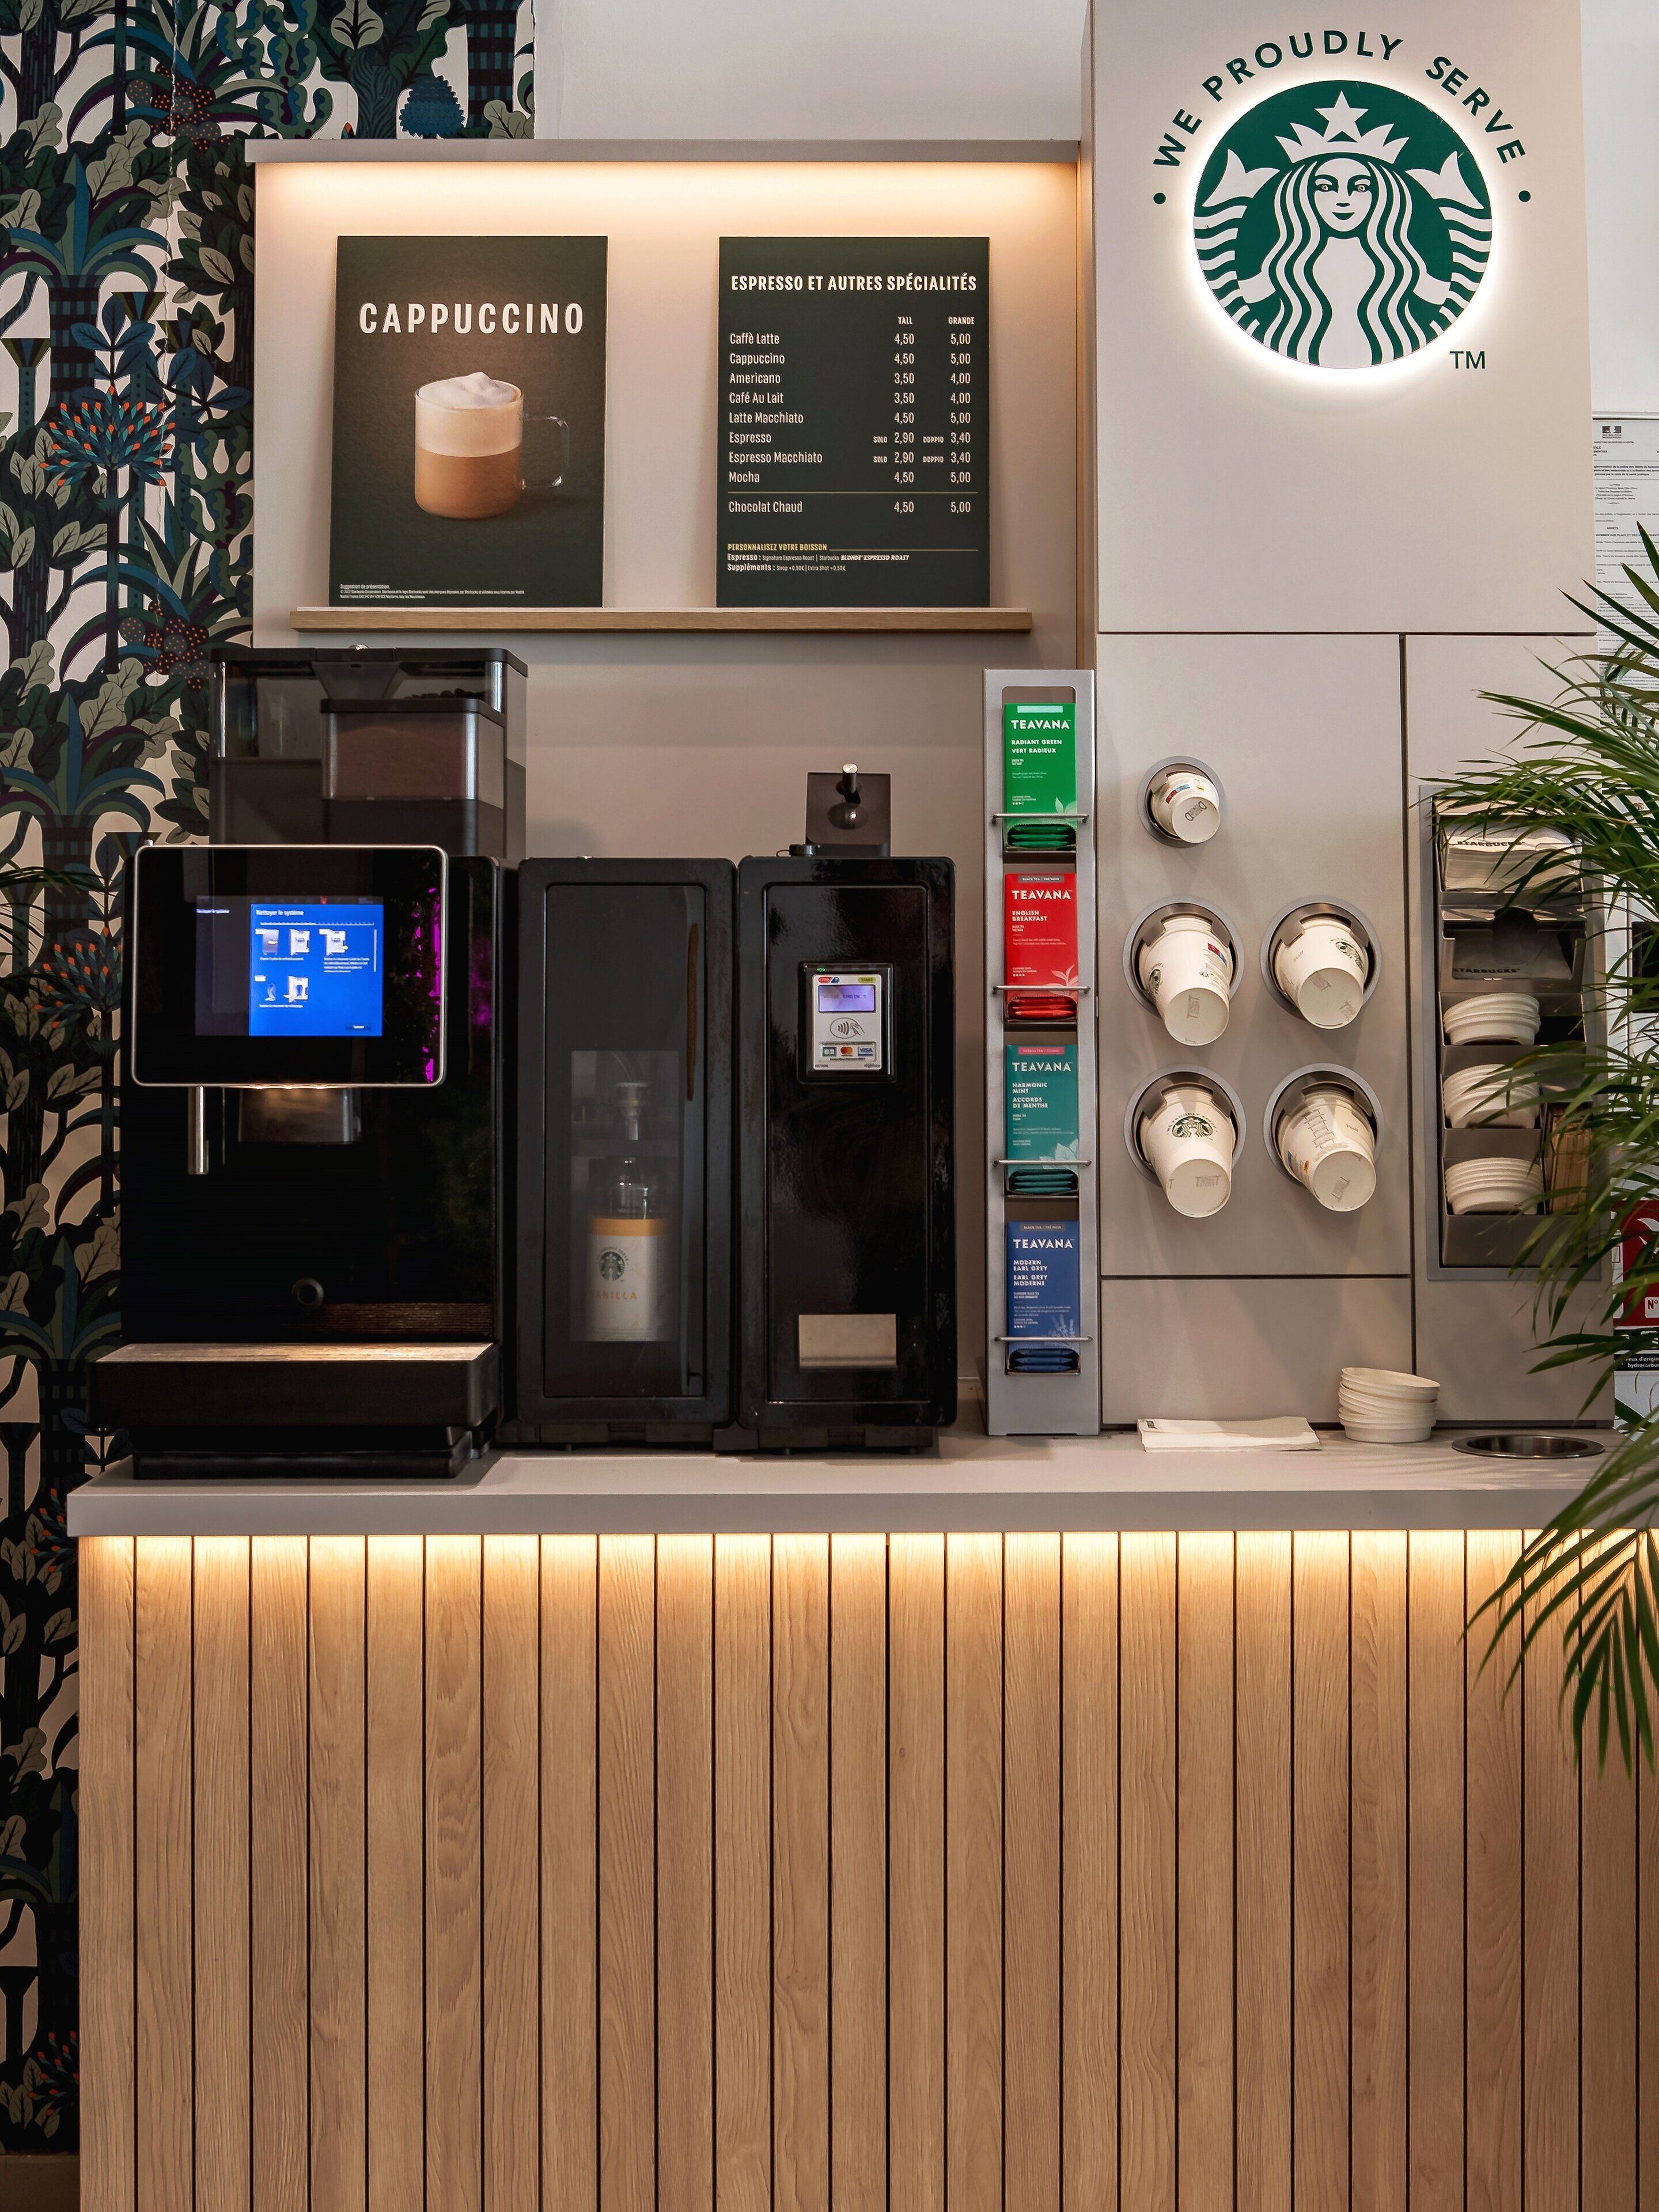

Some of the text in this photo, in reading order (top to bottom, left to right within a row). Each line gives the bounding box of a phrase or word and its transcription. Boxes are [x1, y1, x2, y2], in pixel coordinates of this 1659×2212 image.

[1153, 30, 1526, 168] WE PROUDLY SERVE
[732, 272, 977, 290] ESPRESSO ET AUTRES SPÉCIALITÉS
[359, 302, 584, 334] CAPPUCCINO
[897, 316, 975, 324] TALL GRANDE
[730, 332, 971, 346] Caffè Latte 4,50 5,00
[729, 353, 971, 366] Cappuccino 4,50 5,00
[1449, 351, 1486, 369] TM
[729, 373, 971, 385] Americano 3,50 4,00
[729, 392, 971, 405] Café Au Lait 3,50 4,00
[729, 412, 971, 425] Latte Macchiato 4,50 5,00
[729, 432, 772, 445] Espresso
[894, 432, 915, 445] 2,90
[950, 432, 971, 445] 3,40
[729, 452, 771, 464] Espresso
[774, 452, 823, 463] Macchiato
[894, 452, 915, 464] 2,90
[950, 452, 971, 464] 3,40
[729, 471, 971, 484] Mocha 4,50 5,00
[729, 501, 971, 514] Chocolat Chaud 4,50 5,00
[727, 553, 757, 562] Espresso
[727, 563, 772, 572] Suppléments
